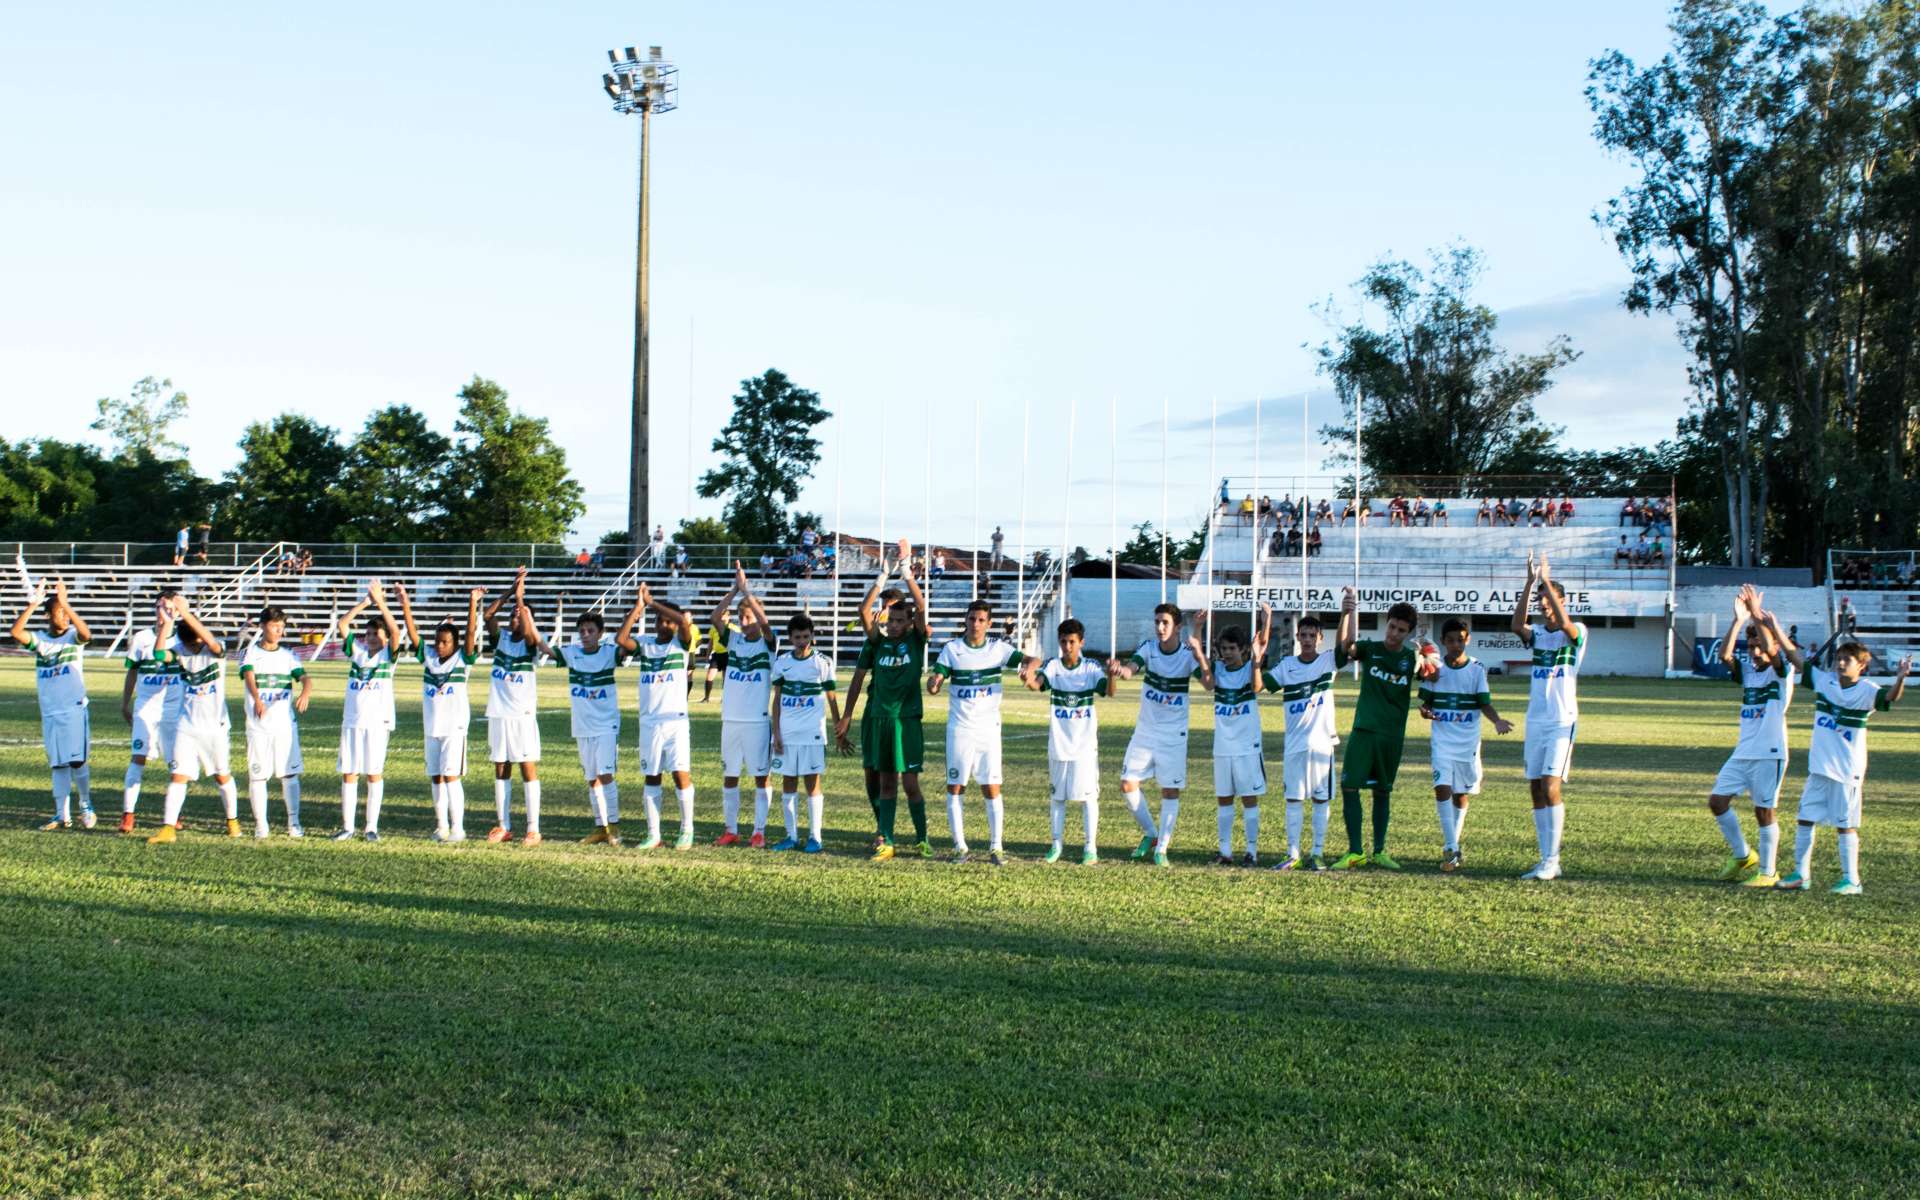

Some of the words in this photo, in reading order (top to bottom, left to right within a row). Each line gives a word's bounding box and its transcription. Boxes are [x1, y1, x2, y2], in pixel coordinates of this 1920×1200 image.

[1223, 588, 1334, 601] PREFEITURA
[1357, 589, 1445, 602] UNICIPAL
[1455, 590, 1479, 602] DO
[1489, 590, 1590, 603] ALEGTE
[1212, 600, 1277, 609] SECRETAA
[1423, 603, 1477, 612] ESPORTE
[1483, 604, 1491, 612] E
[1498, 604, 1541, 613] LAER
[143, 675, 179, 685] CAIXA
[728, 670, 762, 682] CAIXA
[1369, 666, 1408, 686] CAIXA
[571, 687, 607, 699] CAIXA
[957, 687, 992, 699] CAIXA
[1145, 690, 1183, 706] CAIXA
[1054, 708, 1091, 719] CAIXA
[1215, 704, 1250, 717] CAIXA
